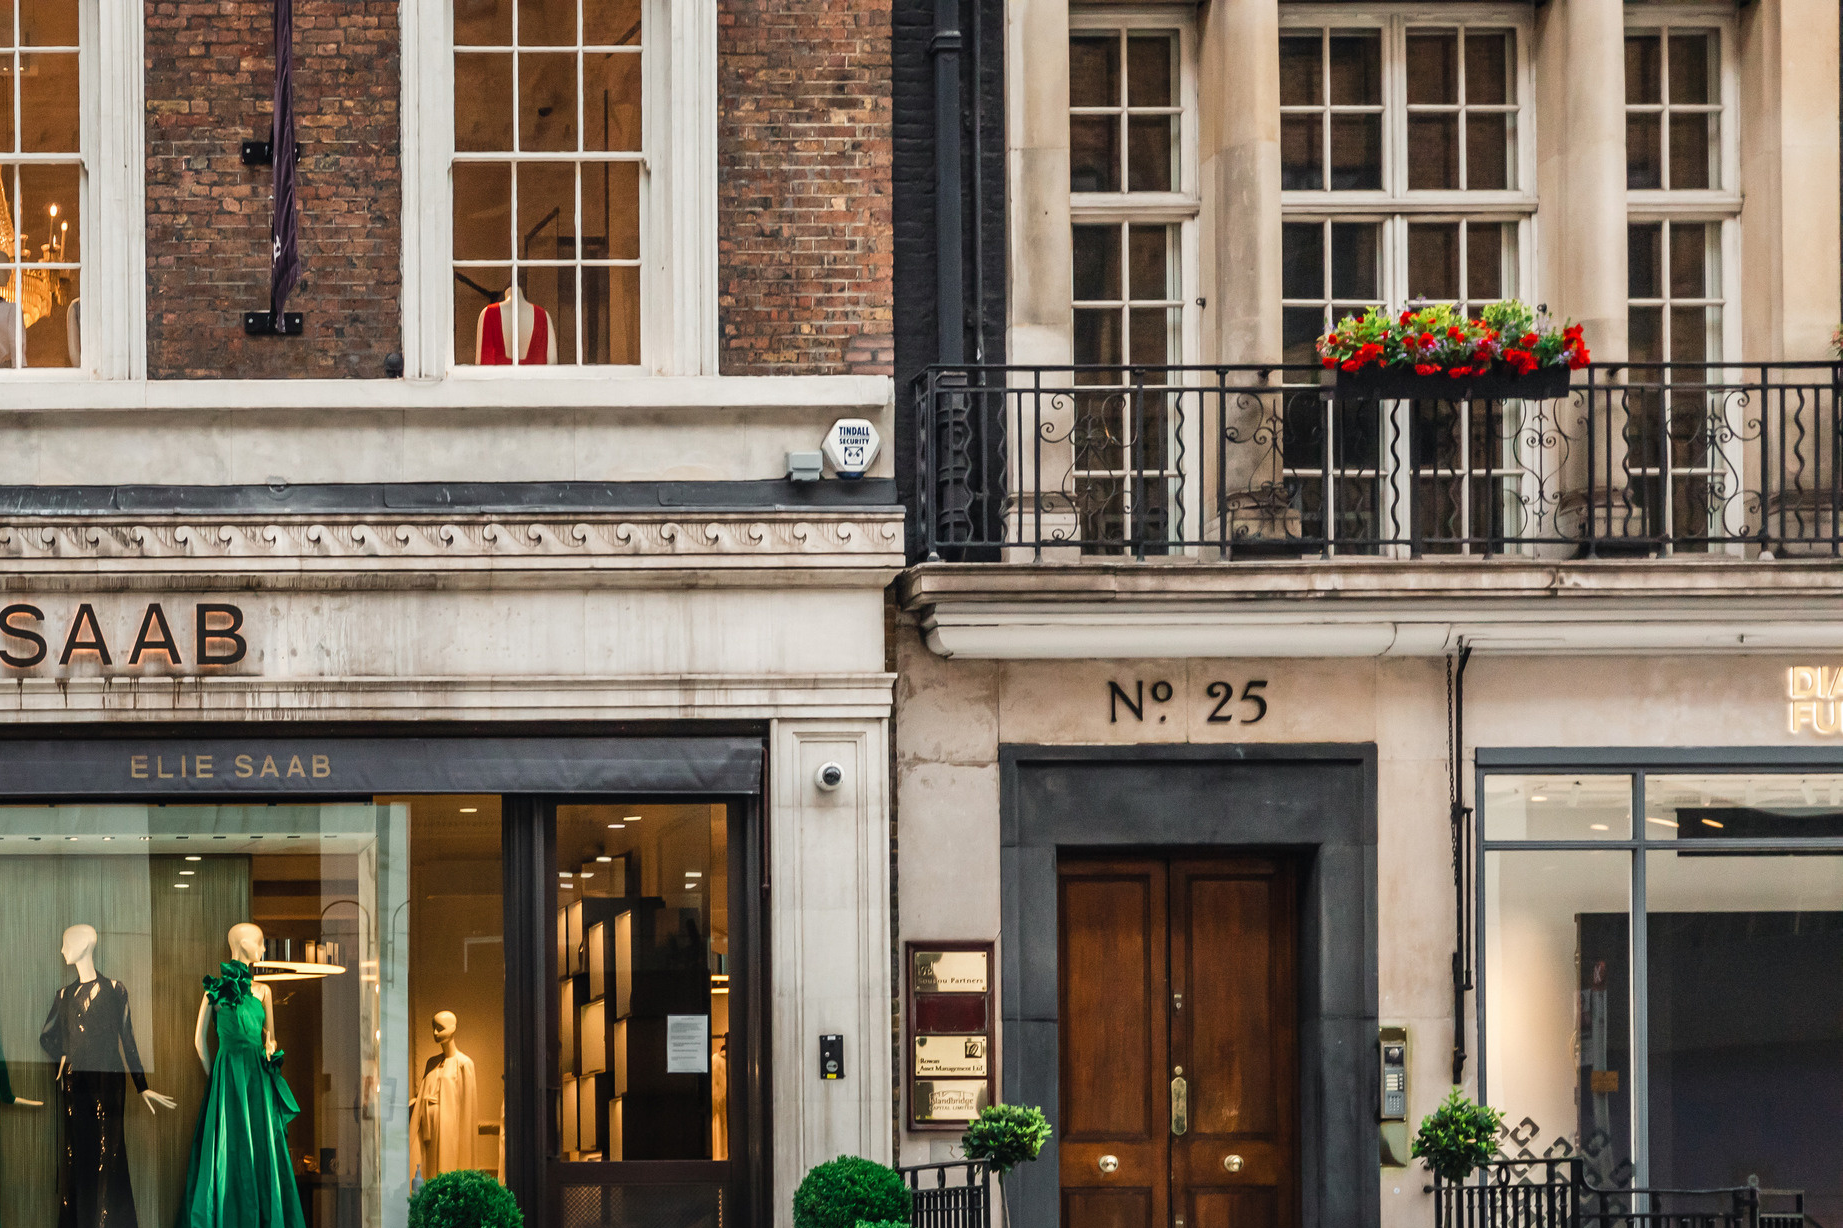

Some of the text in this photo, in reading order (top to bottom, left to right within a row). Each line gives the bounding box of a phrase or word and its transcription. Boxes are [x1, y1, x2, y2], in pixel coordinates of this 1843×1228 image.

[839, 427, 869, 436] TINDALL
[1206, 680, 1269, 724] 25
[131, 754, 332, 779] ELIE SAAB
